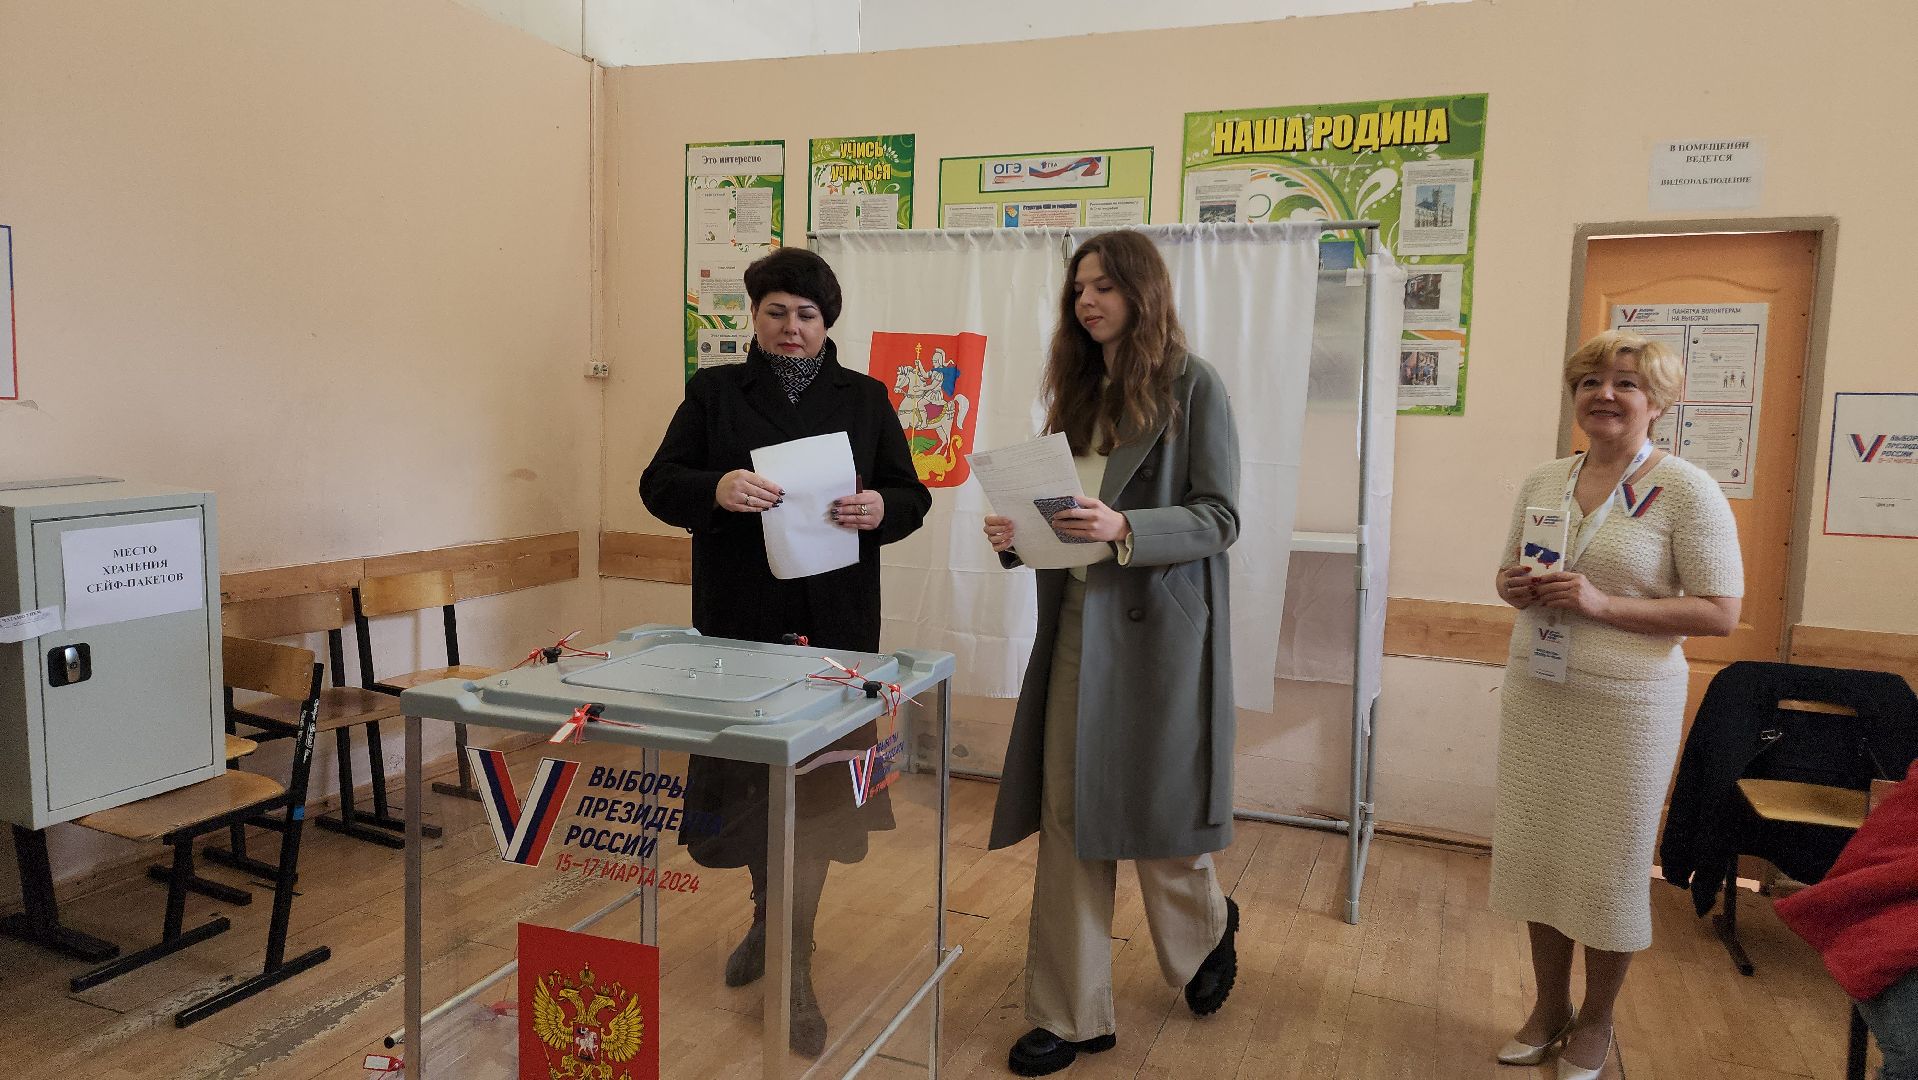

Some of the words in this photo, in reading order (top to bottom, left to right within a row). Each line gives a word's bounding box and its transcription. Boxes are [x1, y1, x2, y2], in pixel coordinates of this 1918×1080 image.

[1213, 115, 1307, 156] НАША
[1312, 107, 1451, 154] РОДИНА
[1669, 144, 1676, 152] В
[1678, 141, 1750, 152] ПОМЕЩЕНИИ
[702, 155, 717, 165] Это
[719, 154, 762, 165] интересно
[1686, 154, 1733, 163] ВЕДЕТСЯ
[993, 163, 1022, 175] ОГЭ
[1660, 176, 1752, 186] ВИДЕОНАБЛЮДЕНИЕ
[113, 544, 157, 559] МЕСТО
[102, 558, 168, 576] ХРАНЕНИЯ
[86, 571, 184, 594] СЕЙФ-ПАКЕТОВ
[575, 796, 721, 837] ПРЕЗИДЕ
[564, 824, 657, 859] РОССИИ
[600, 863, 655, 888] МАРТА
[657, 870, 700, 894] 2024
